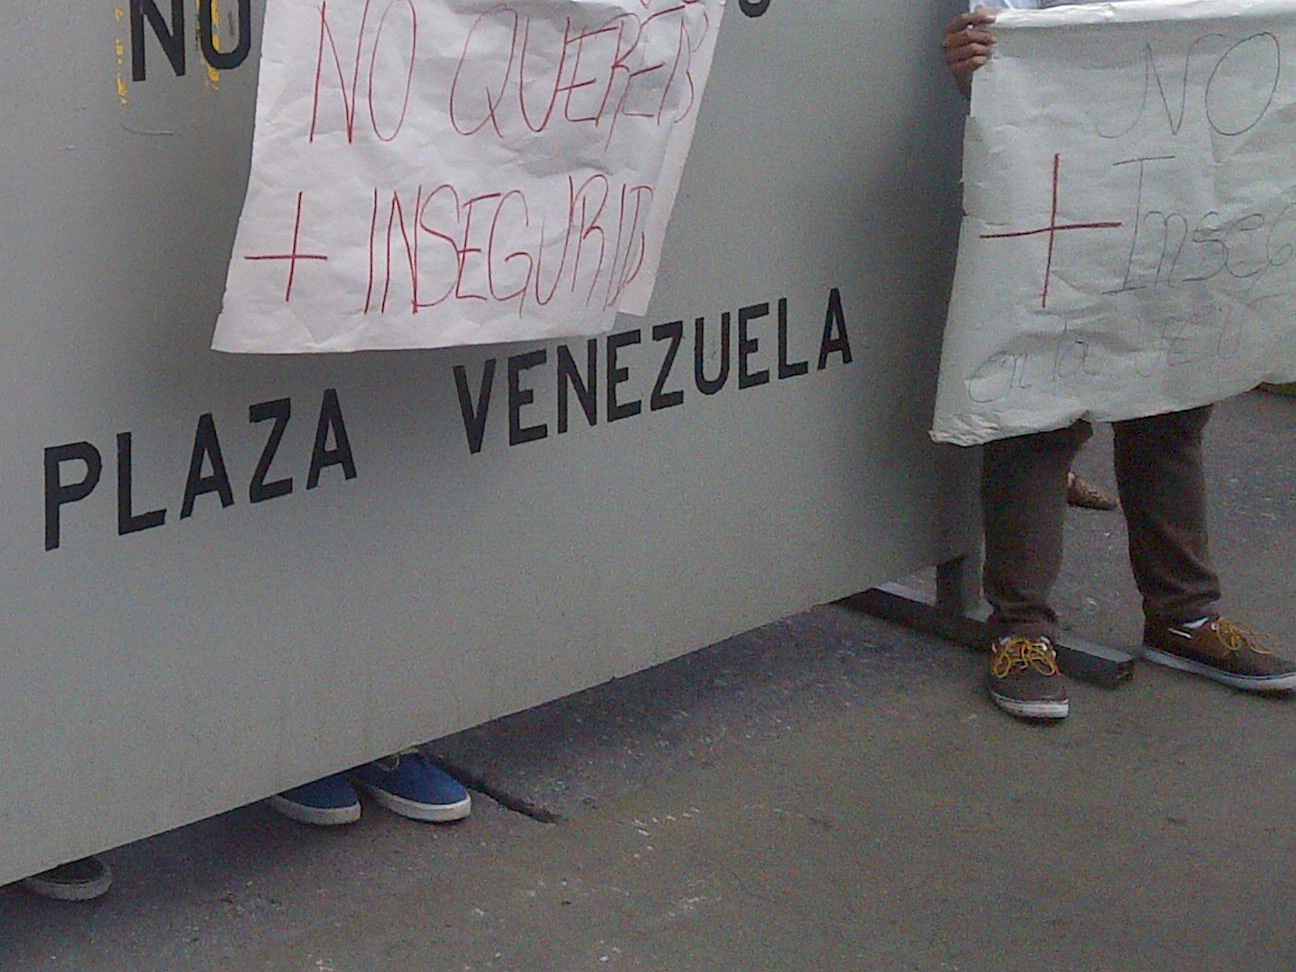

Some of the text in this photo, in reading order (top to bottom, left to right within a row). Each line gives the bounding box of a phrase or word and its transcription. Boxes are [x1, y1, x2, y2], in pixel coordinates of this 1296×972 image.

[1097, 31, 1281, 139] NO
[44, 287, 854, 551] PLAZA VENEZUELA
